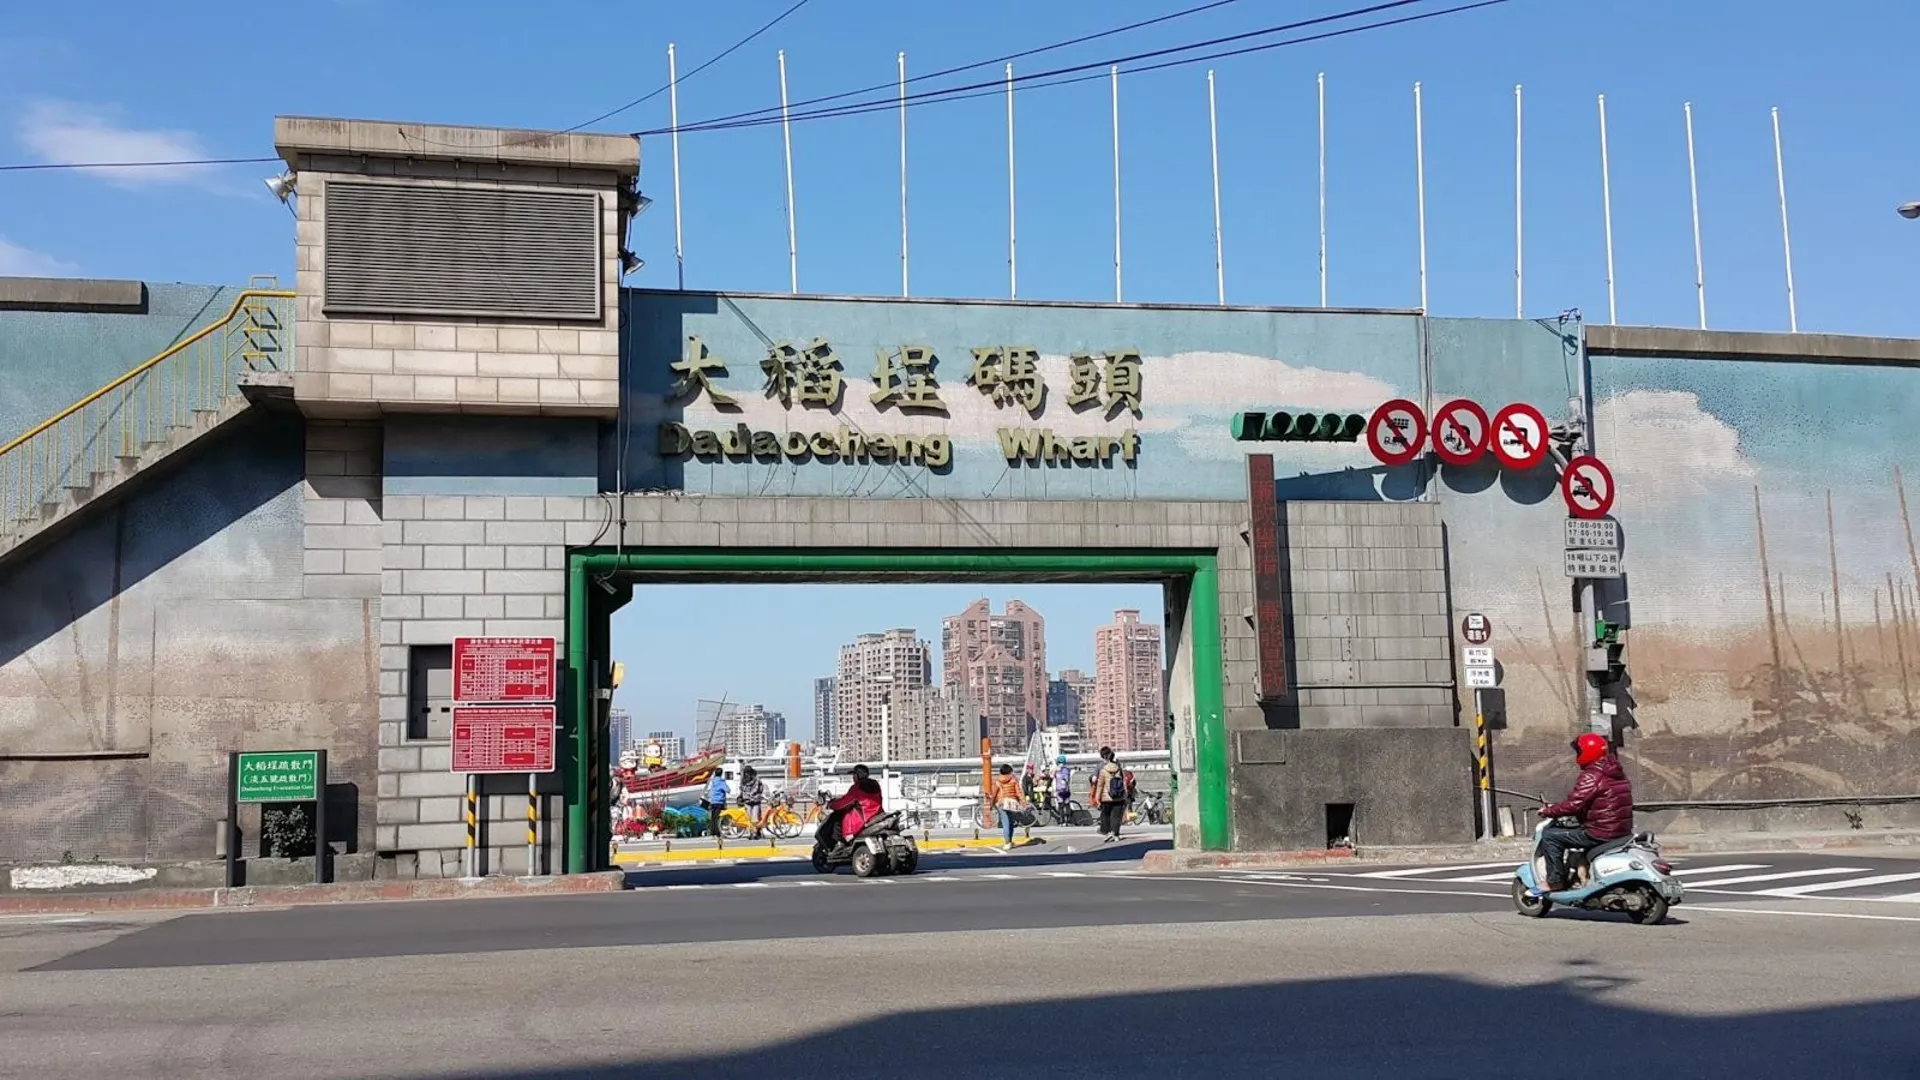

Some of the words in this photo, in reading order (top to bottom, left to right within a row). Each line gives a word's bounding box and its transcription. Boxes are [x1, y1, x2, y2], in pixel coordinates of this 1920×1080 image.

[670, 335, 1140, 411] 大稻埕碼頭
[659, 421, 951, 467] Dadaocheng
[997, 428, 1139, 460] Wharf
[243, 760, 313, 771] 大稻埕疏散門
